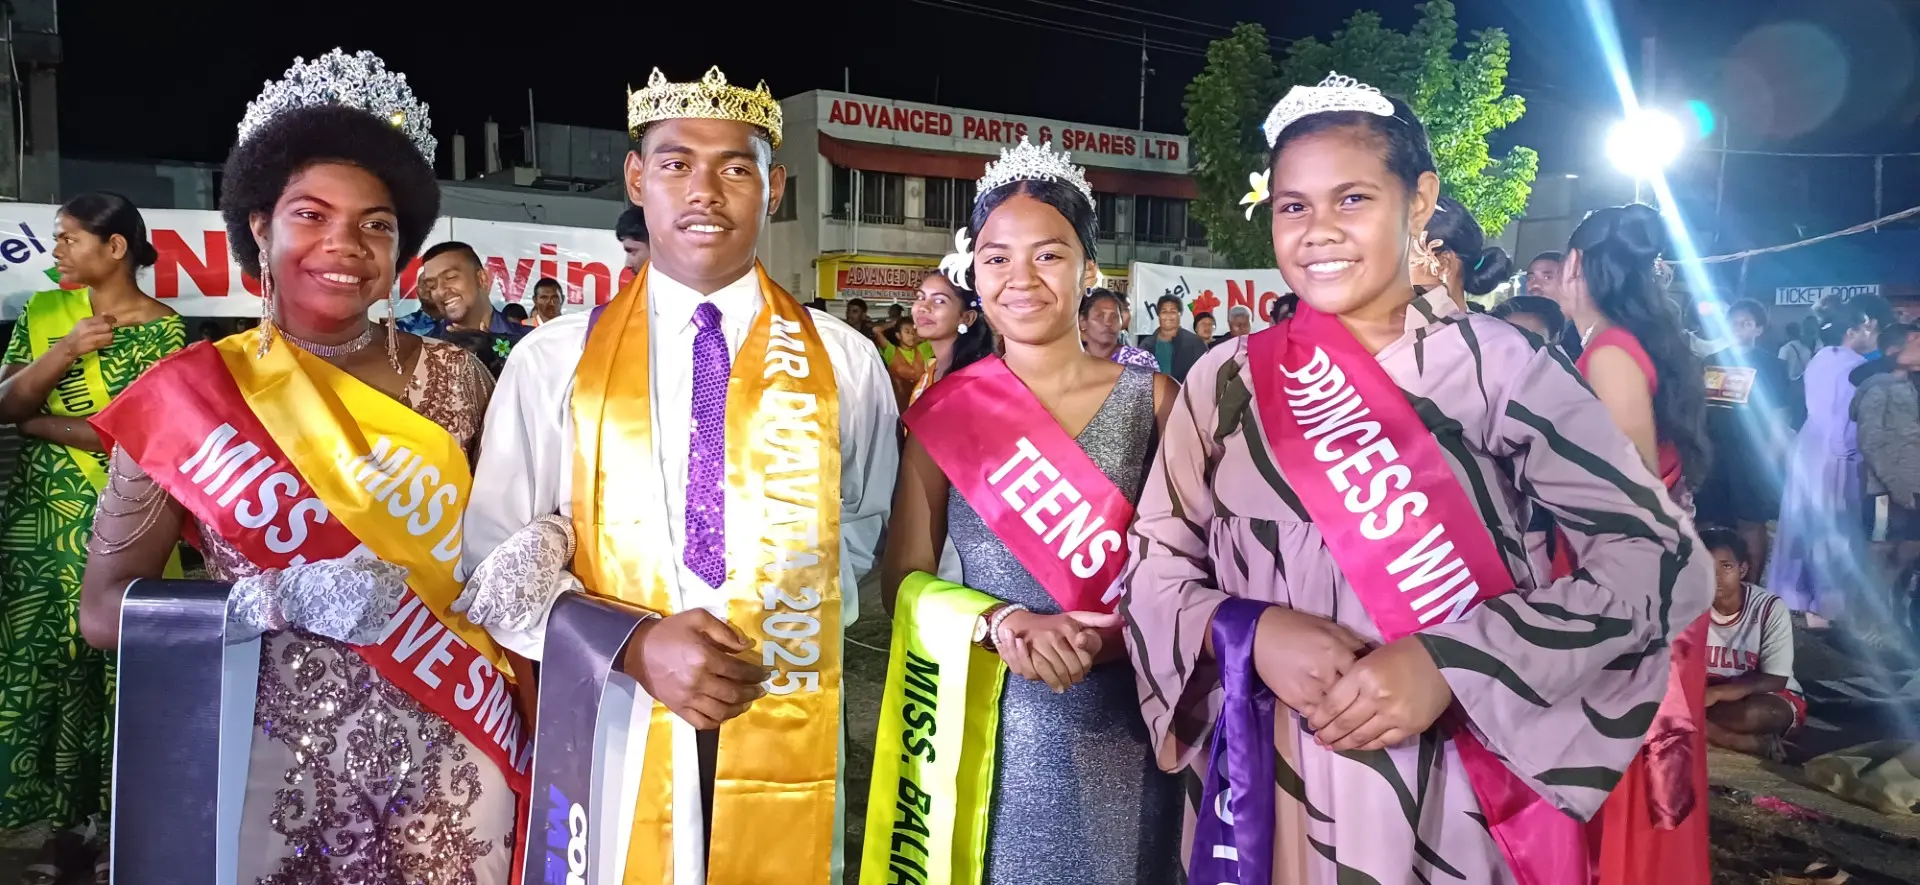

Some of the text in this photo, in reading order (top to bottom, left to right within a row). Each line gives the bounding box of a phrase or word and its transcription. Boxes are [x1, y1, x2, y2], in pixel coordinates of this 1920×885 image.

[828, 99, 1180, 160] ADVANCED PARTS & SPARES LTD
[0, 221, 46, 272] el
[845, 266, 907, 287] ADVANCED
[1780, 287, 1824, 303] TICKET
[763, 314, 810, 386] MR
[1279, 346, 1429, 540] PRINCESS
[345, 434, 458, 536] MISS
[987, 436, 1122, 579] TEENS
[762, 586, 822, 697] 2025
[1705, 645, 1758, 671] ULLS
